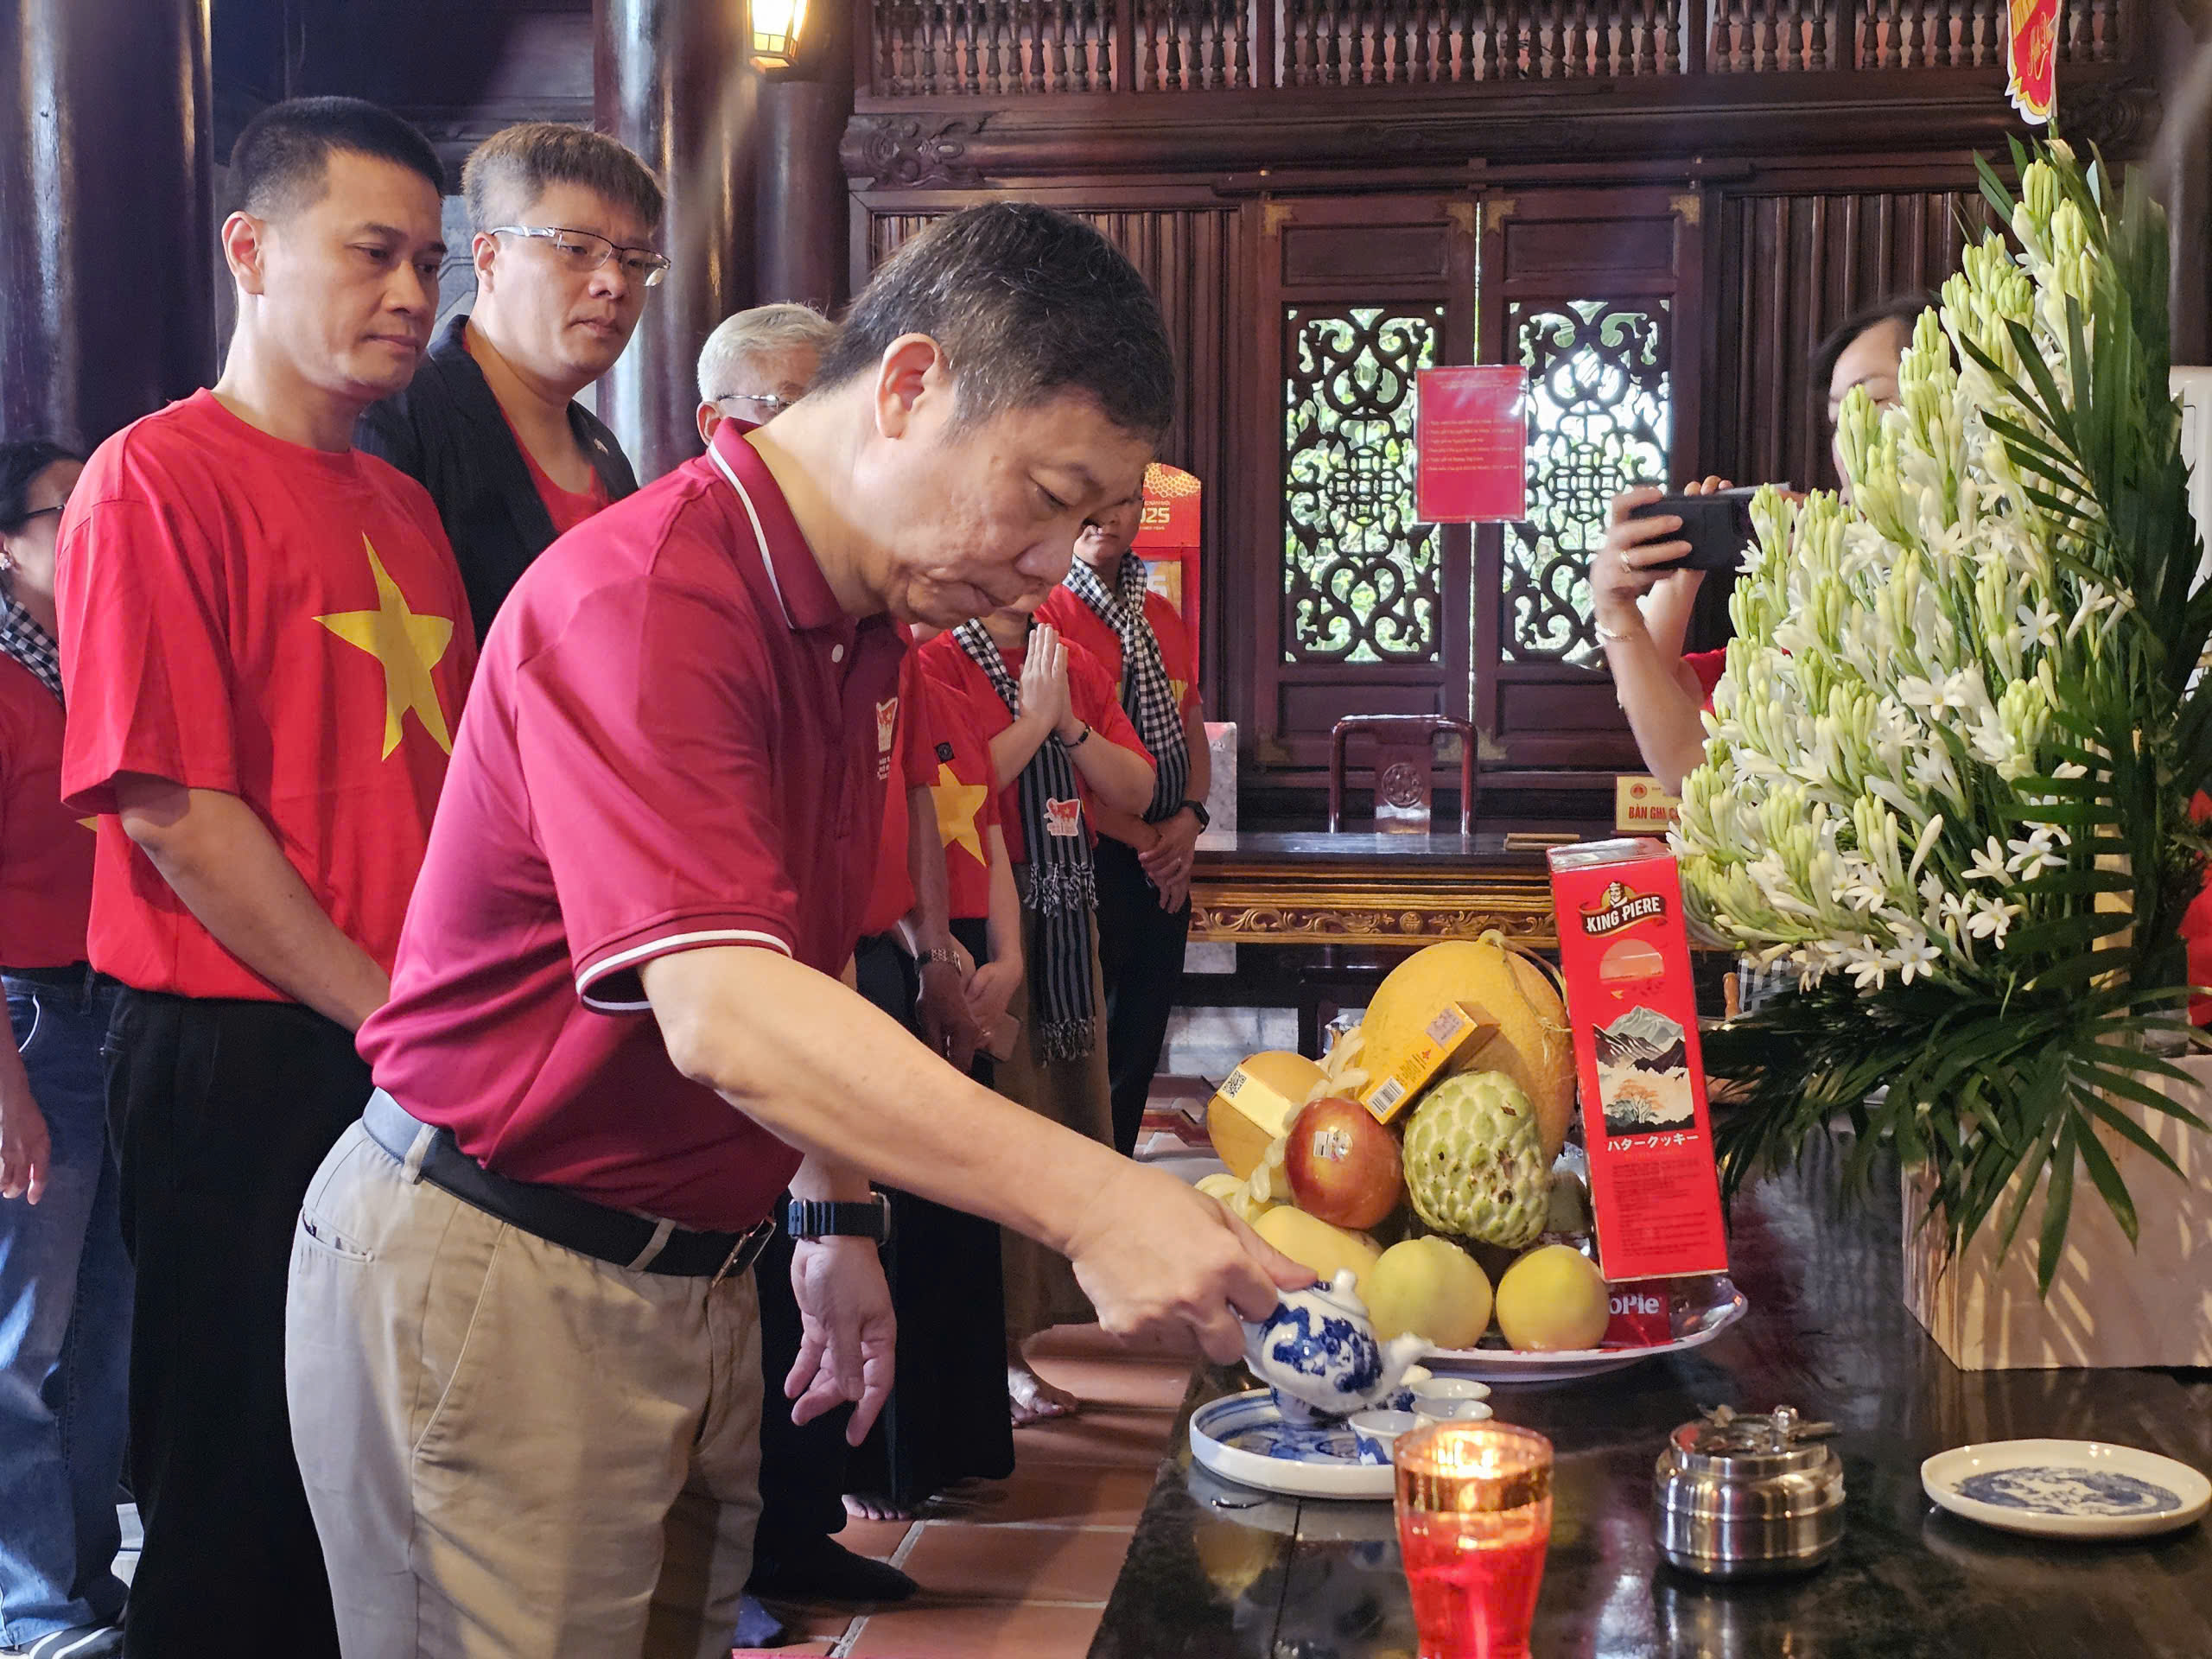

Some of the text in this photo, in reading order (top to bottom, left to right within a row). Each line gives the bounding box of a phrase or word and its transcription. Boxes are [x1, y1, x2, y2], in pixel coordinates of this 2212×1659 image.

[1586, 896, 1661, 932] KING PIERE
[1610, 1293, 1659, 1314] oPie
